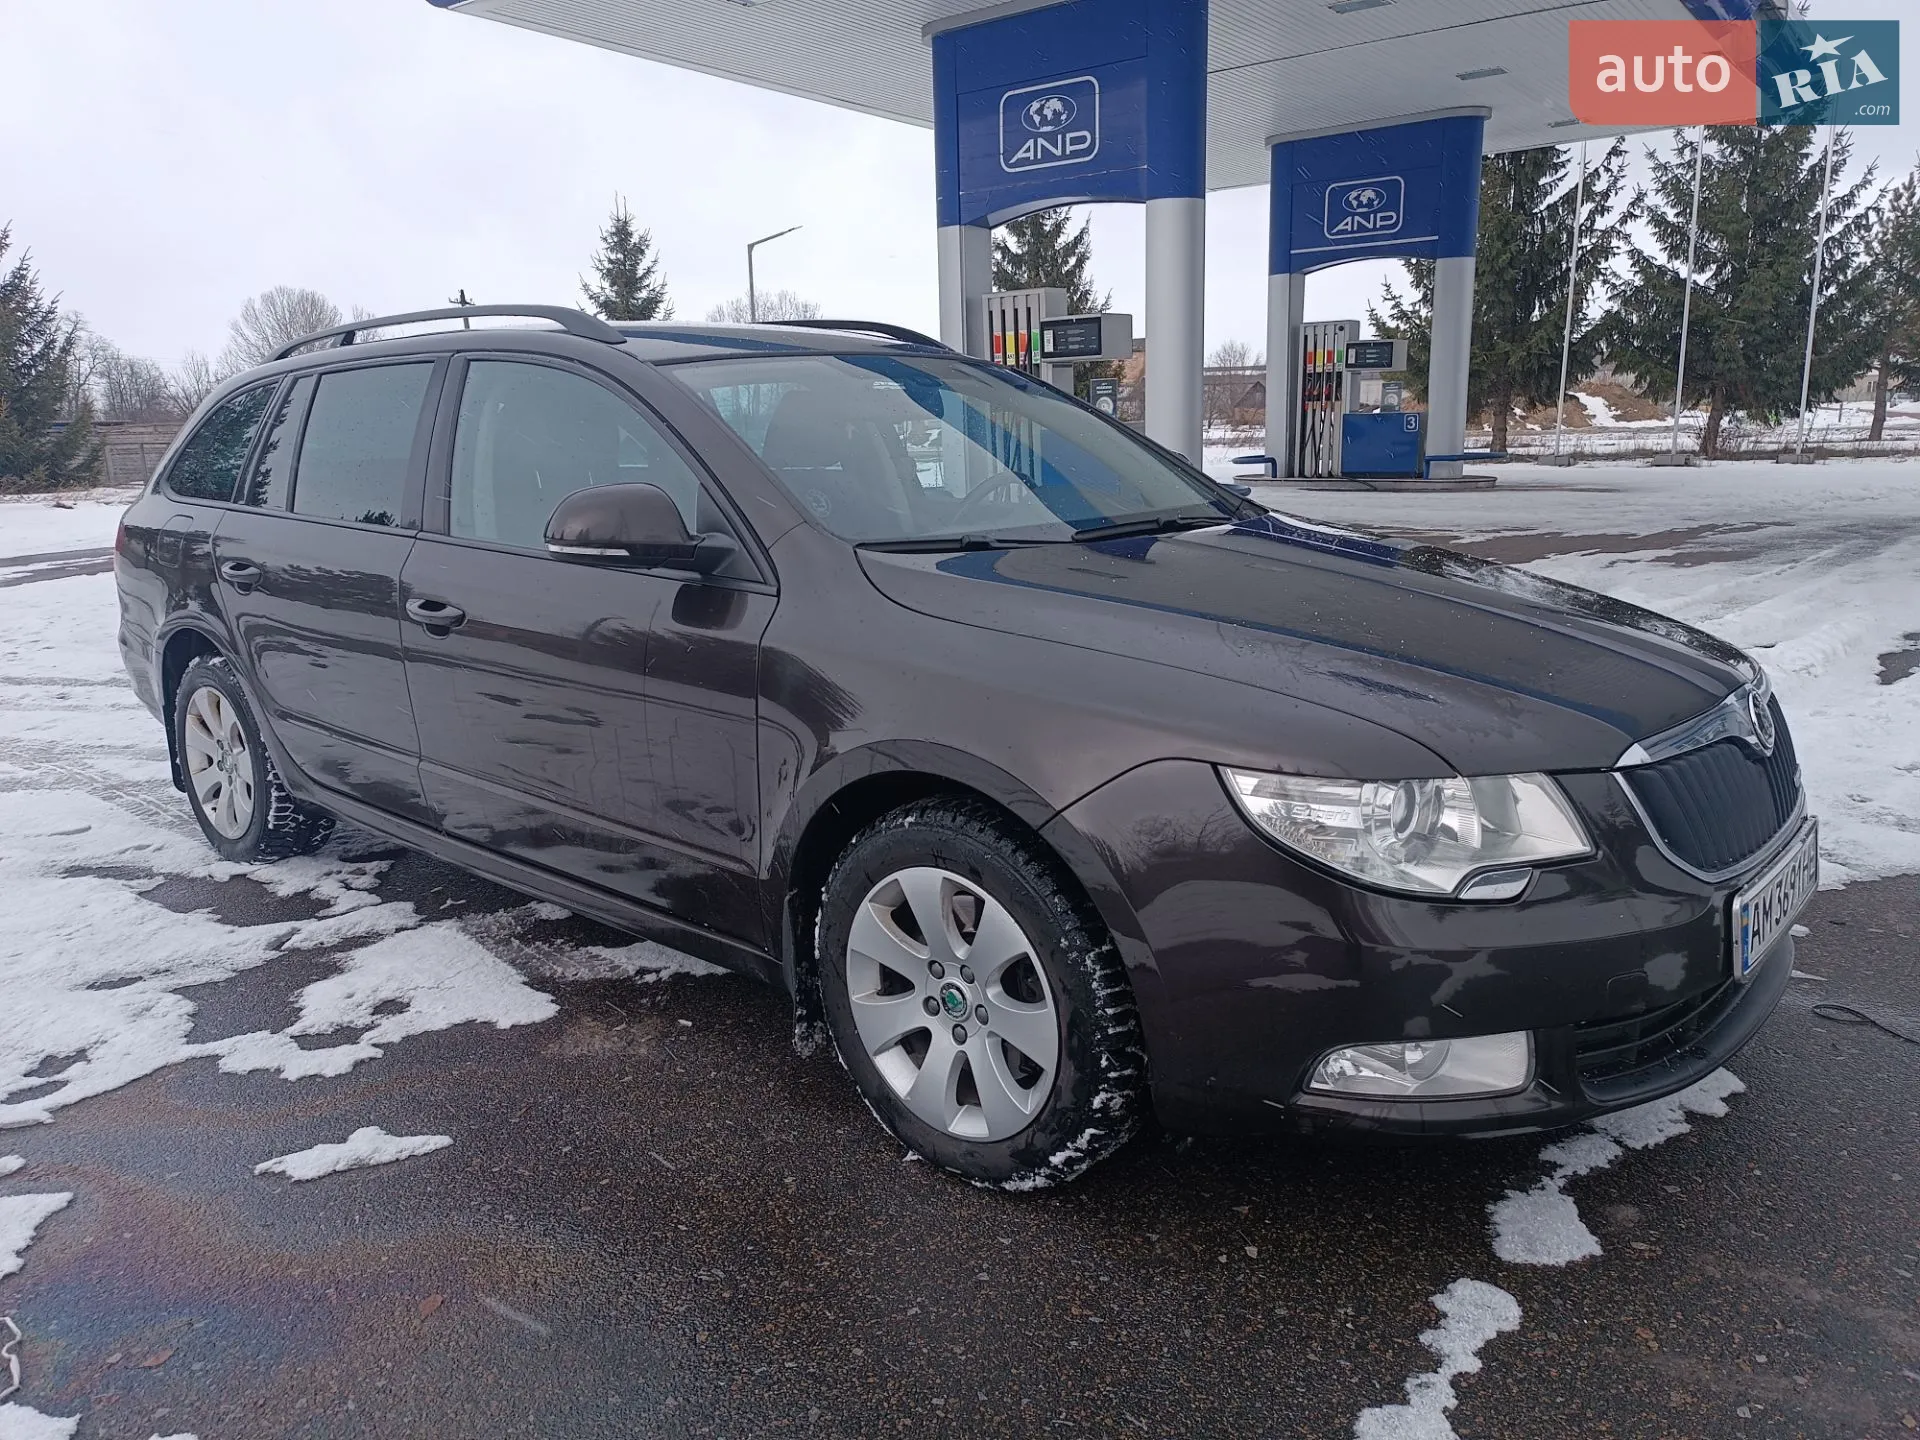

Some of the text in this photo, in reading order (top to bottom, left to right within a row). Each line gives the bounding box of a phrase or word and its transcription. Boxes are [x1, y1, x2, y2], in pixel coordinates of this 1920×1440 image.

[1008, 130, 1092, 164] ANP
[1331, 211, 1397, 234] ANP
[1407, 416, 1416, 429] 3
